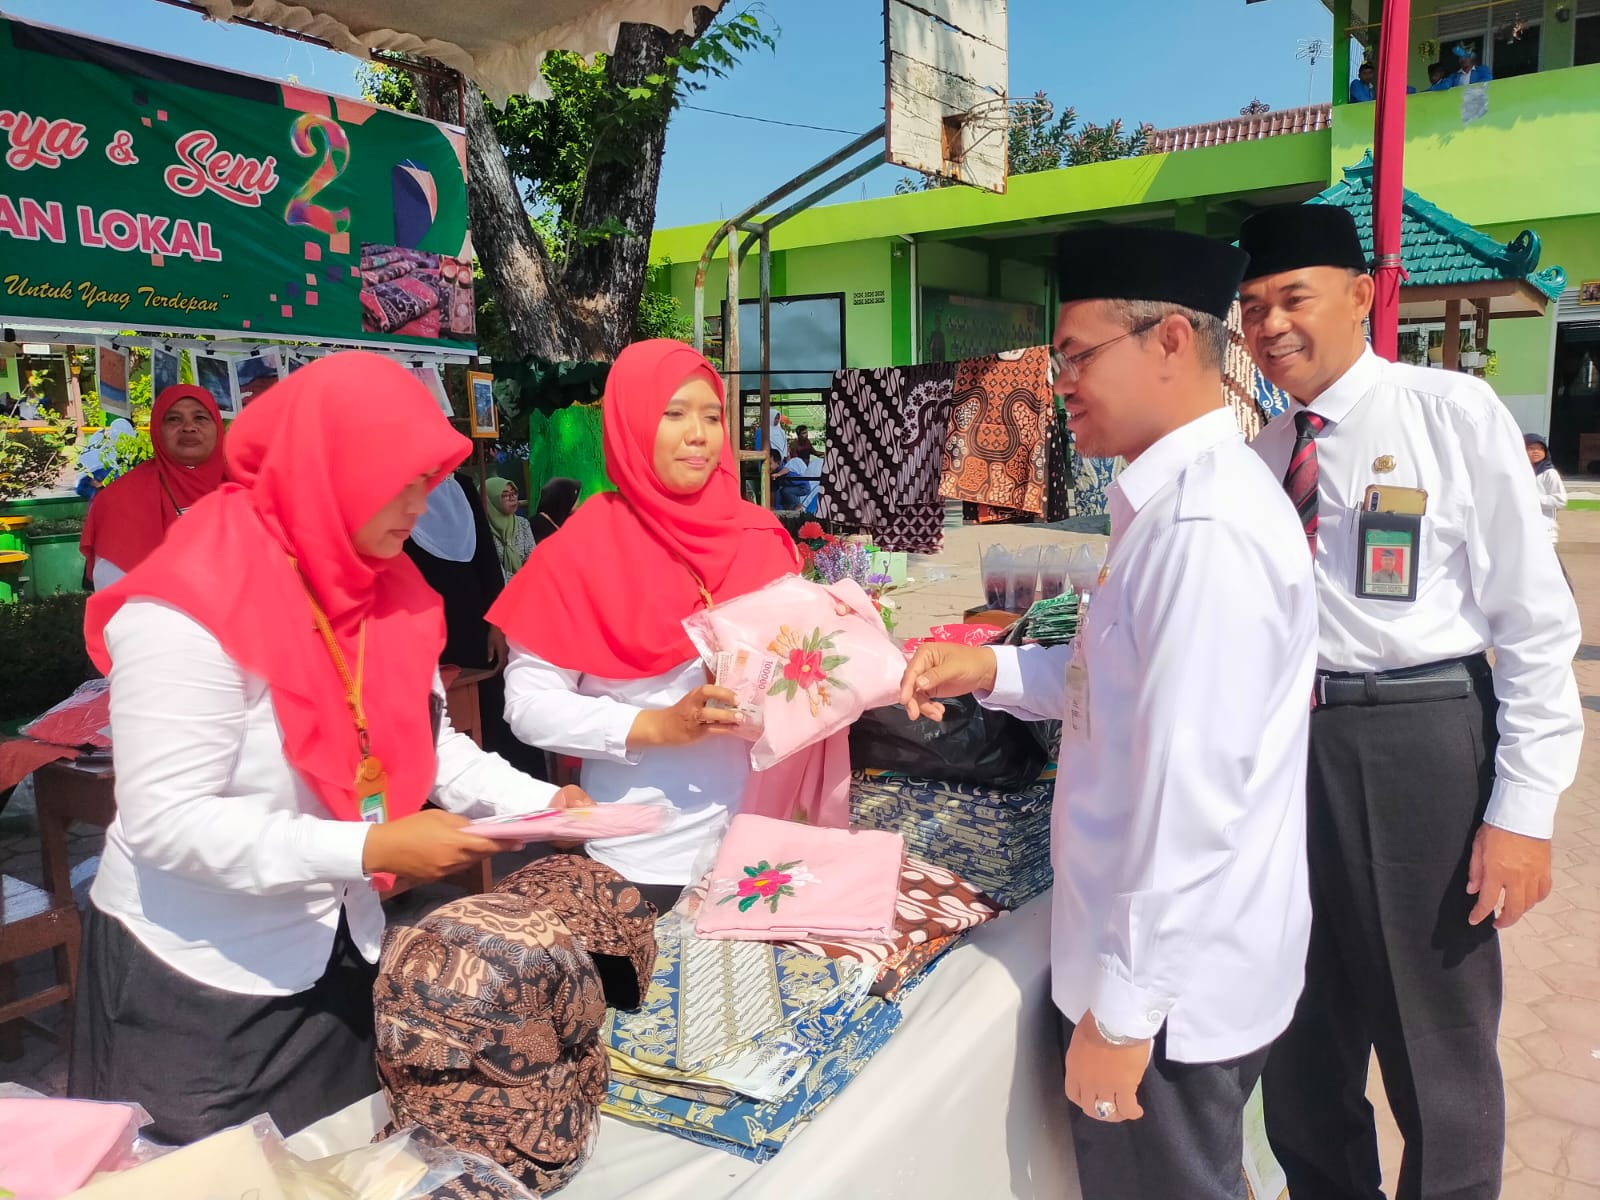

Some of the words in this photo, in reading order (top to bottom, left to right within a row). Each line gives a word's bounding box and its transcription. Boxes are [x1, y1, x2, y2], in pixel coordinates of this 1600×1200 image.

[105, 130, 139, 165] &
[164, 130, 279, 207] Seni
[77, 205, 222, 261] LOKAL
[4, 274, 72, 299] Untuk
[78, 281, 130, 310] Yang
[758, 660, 773, 690] 100000
